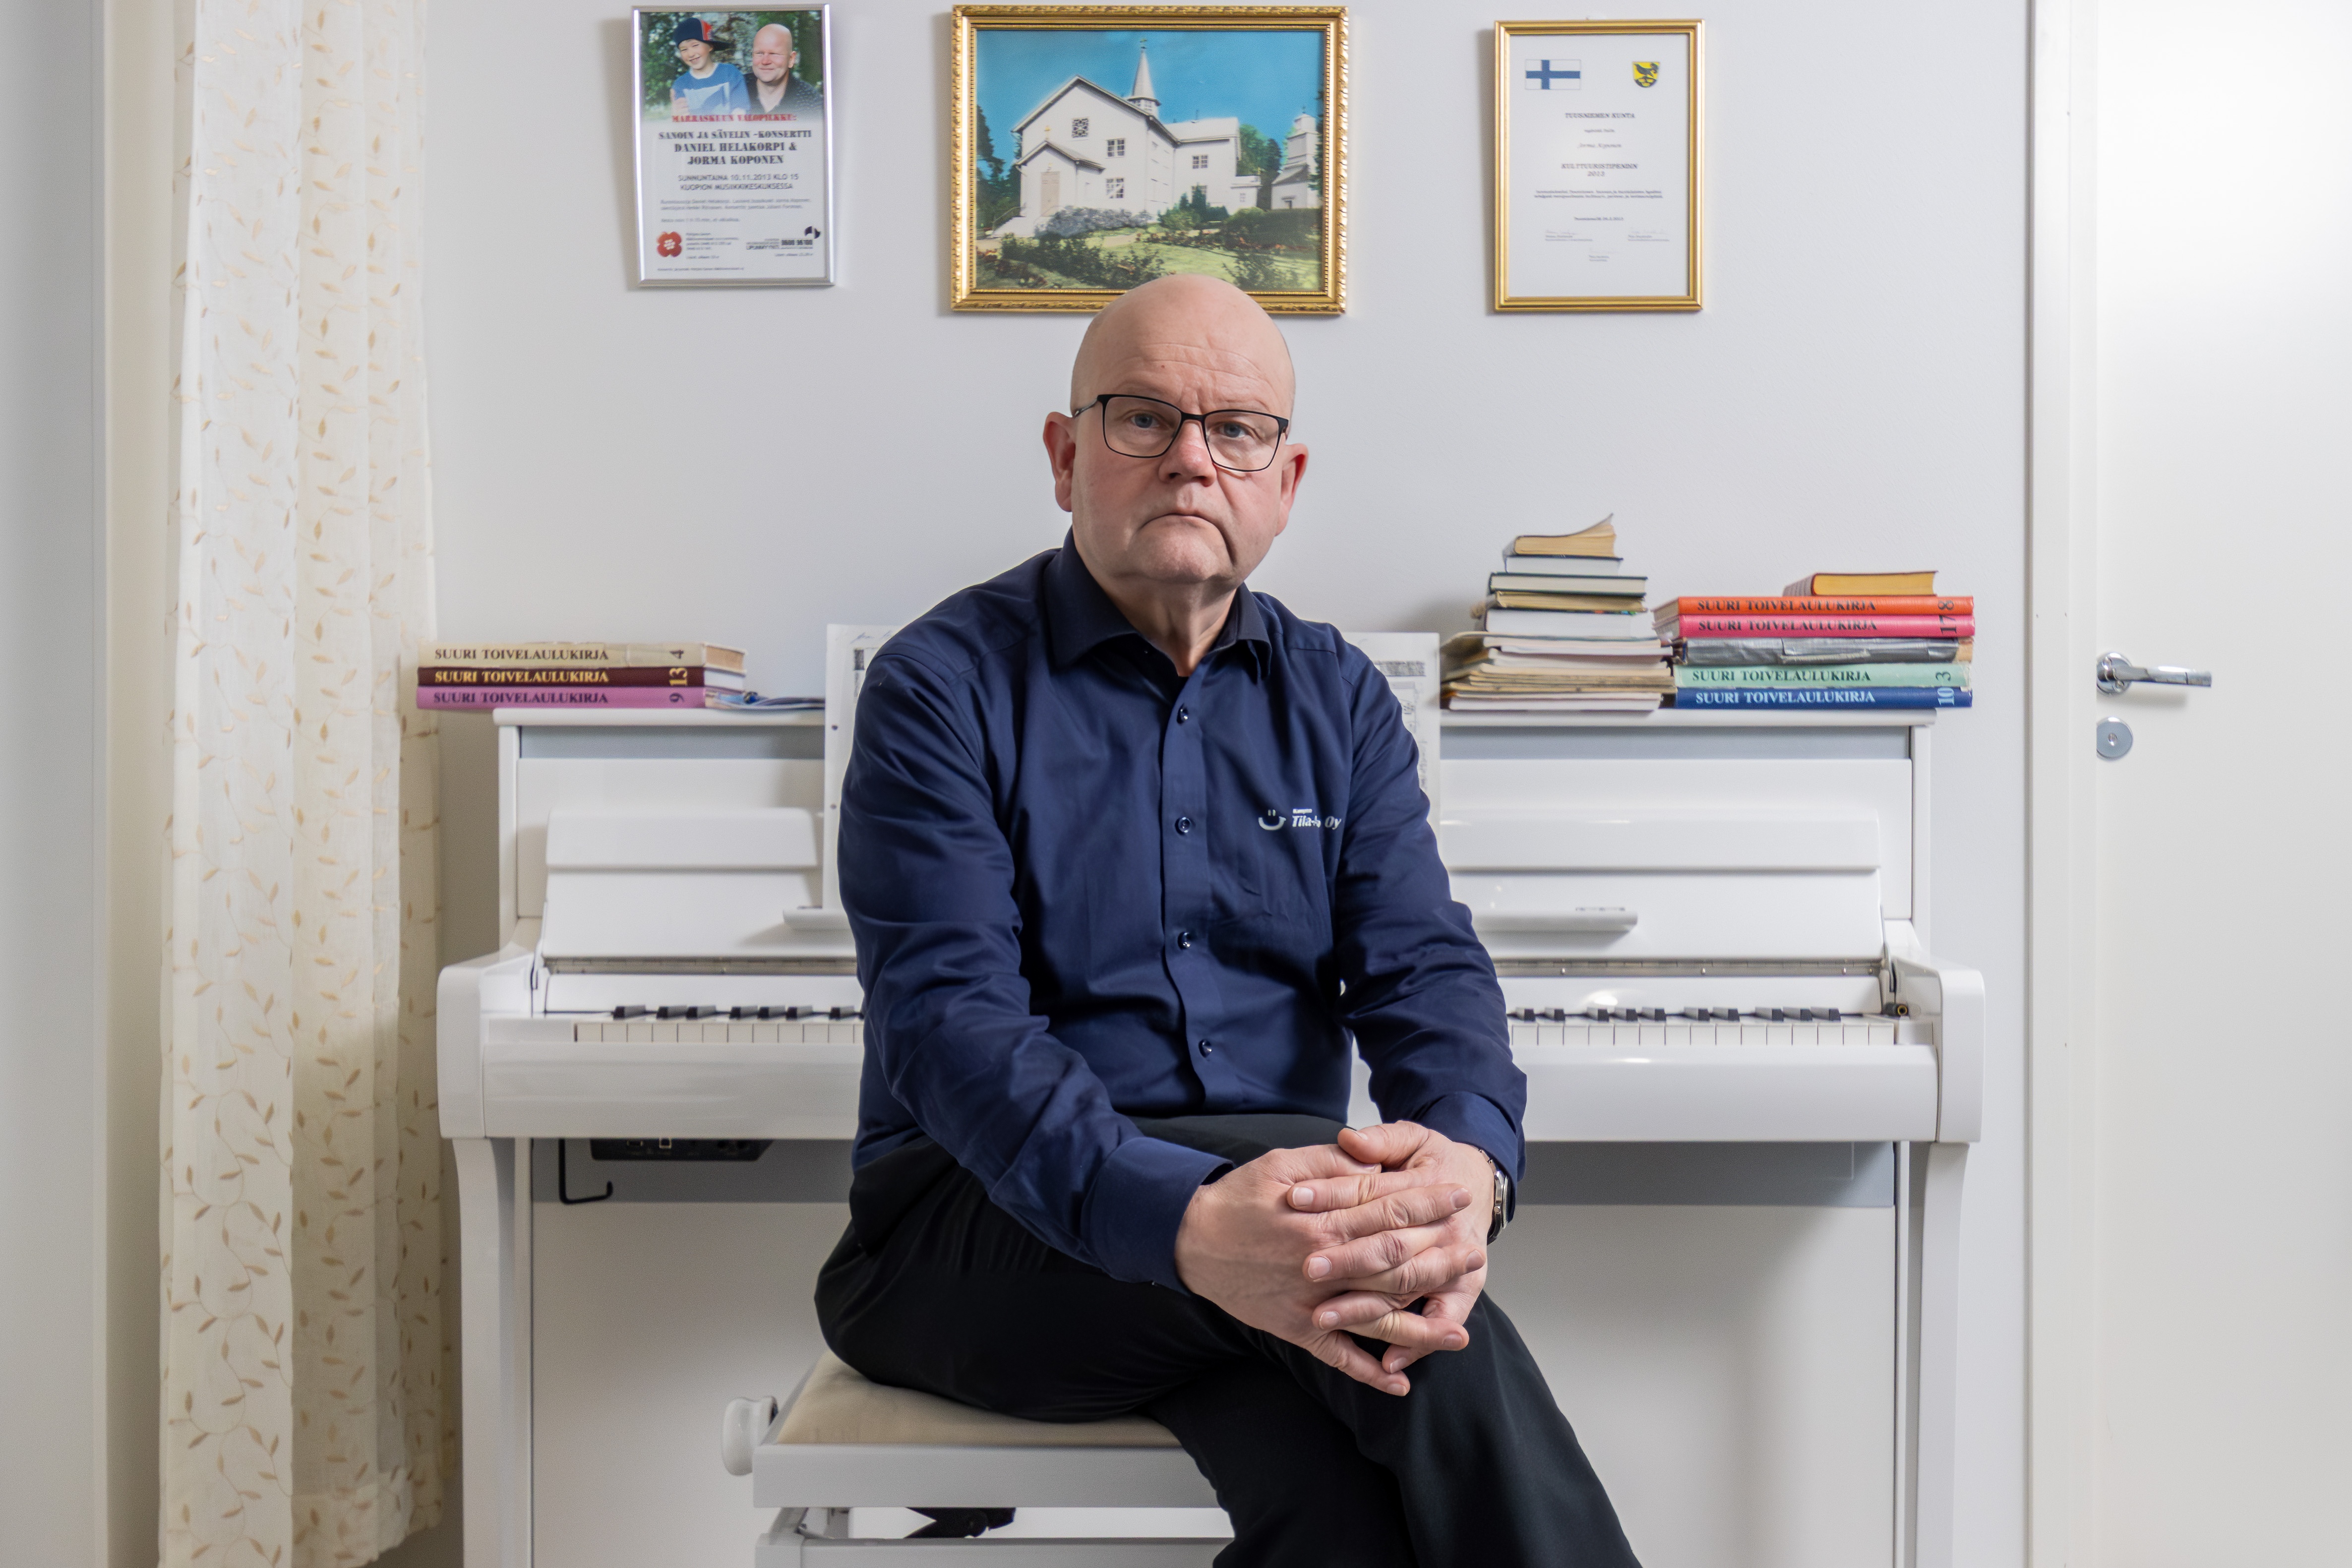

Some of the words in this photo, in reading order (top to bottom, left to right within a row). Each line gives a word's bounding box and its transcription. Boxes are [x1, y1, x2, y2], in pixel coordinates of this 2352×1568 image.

[711, 129, 750, 139] SÄVELIN
[674, 143, 716, 152] DANIEL
[719, 142, 785, 152] HELAKORPI
[788, 142, 797, 151] &
[687, 156, 726, 165] JORMA
[730, 155, 784, 165] KOPONEN
[1697, 600, 1741, 610] SUURI
[1746, 600, 1875, 610] TOIVELAULUKIRJA
[1937, 600, 1954, 610] 8
[1698, 620, 1742, 631] SUURI
[1747, 619, 1877, 630] TOIVELAULUKIRJA
[1938, 614, 1957, 634] 17
[434, 649, 477, 660] SUURI
[482, 649, 609, 660] TOIVELAULUKIRJA
[669, 650, 684, 659] 4
[434, 670, 477, 683] SUURI
[482, 670, 609, 683] TOIVELAULUKIRJA
[669, 667, 688, 686] 13
[1692, 670, 1735, 681] SUURI
[1740, 670, 1871, 681] TOIVELAULUKIRJA
[1935, 671, 1951, 681] 3
[434, 692, 476, 703] SUURI
[480, 692, 608, 703] TOIVELAULUKIRJA
[1696, 691, 1739, 704] SUURI
[1744, 691, 1875, 703] TOIVELAULUKIRJA
[1937, 687, 1955, 705] 10
[1325, 815, 1342, 830] Oy
